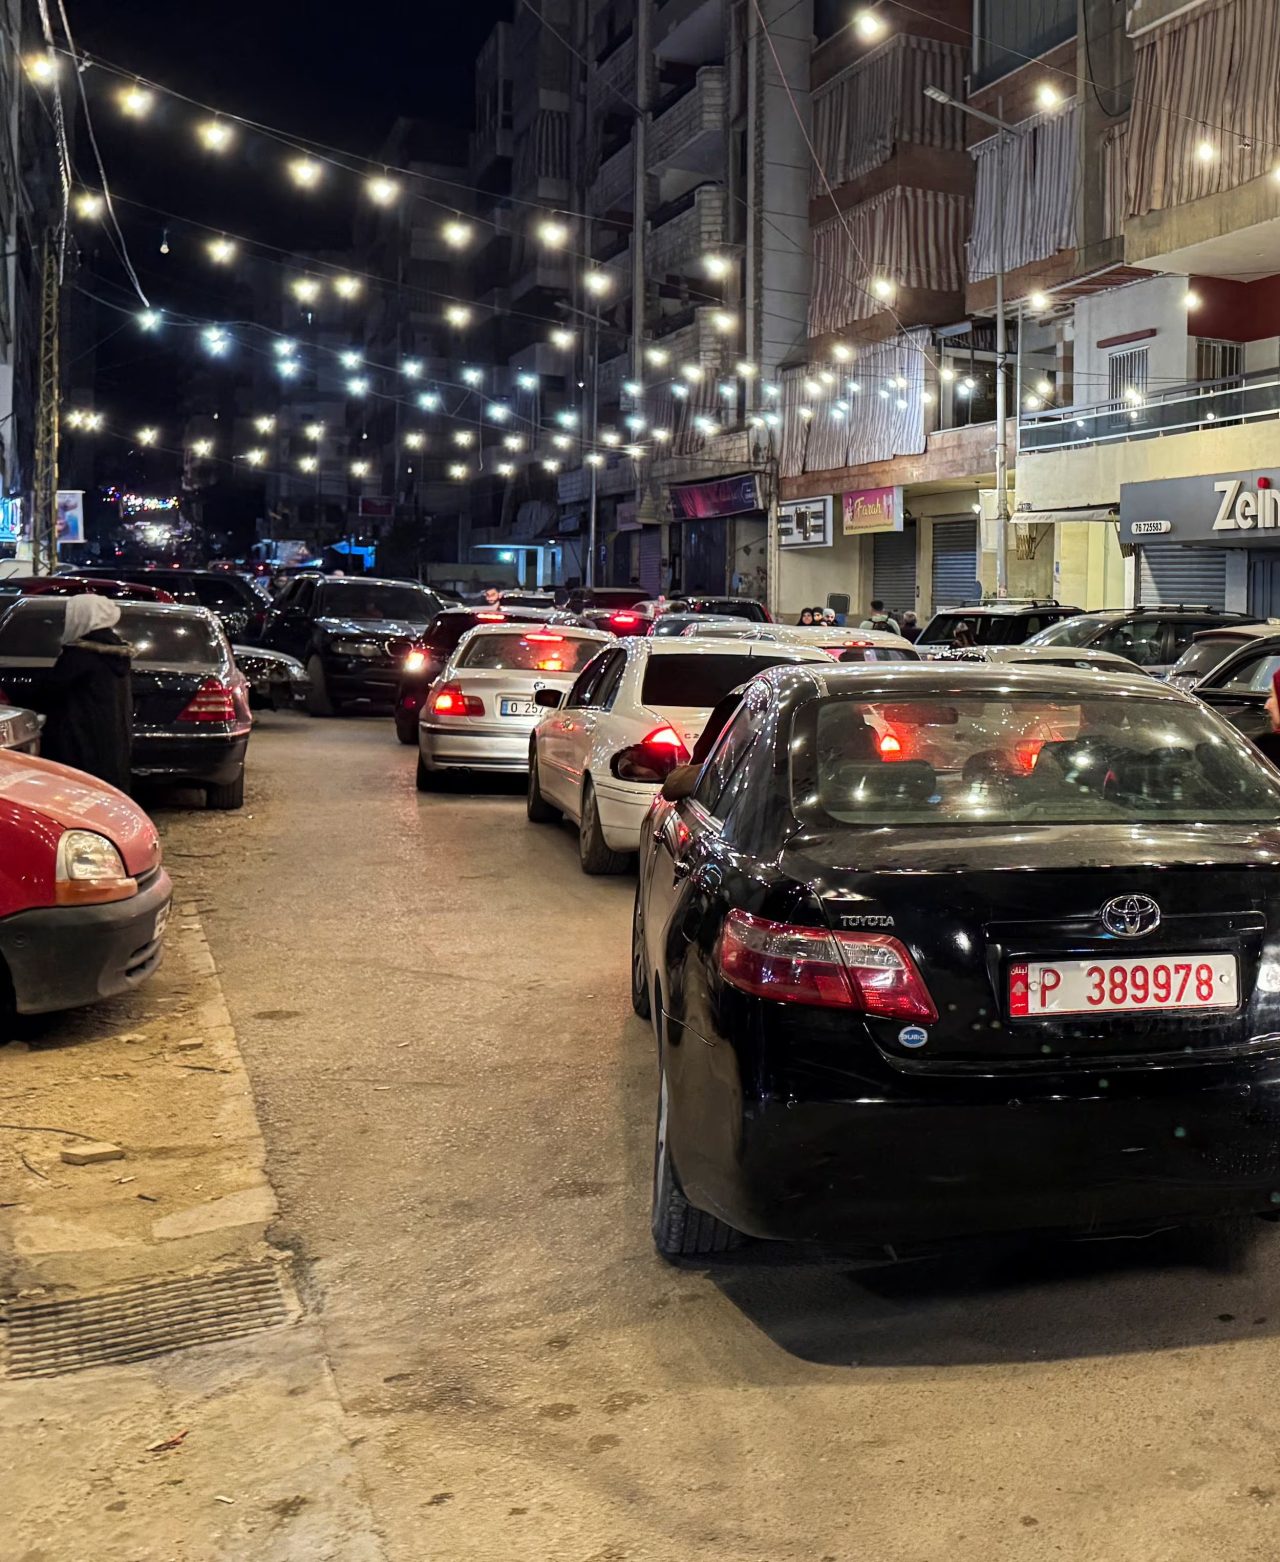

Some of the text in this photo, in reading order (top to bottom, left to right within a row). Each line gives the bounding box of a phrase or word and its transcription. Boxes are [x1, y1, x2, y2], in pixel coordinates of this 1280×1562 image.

[854, 496, 881, 518] Farah
[1135, 523, 1142, 532] 76
[840, 915, 895, 927] TOYOTA
[1040, 963, 1214, 1009] P 389978
